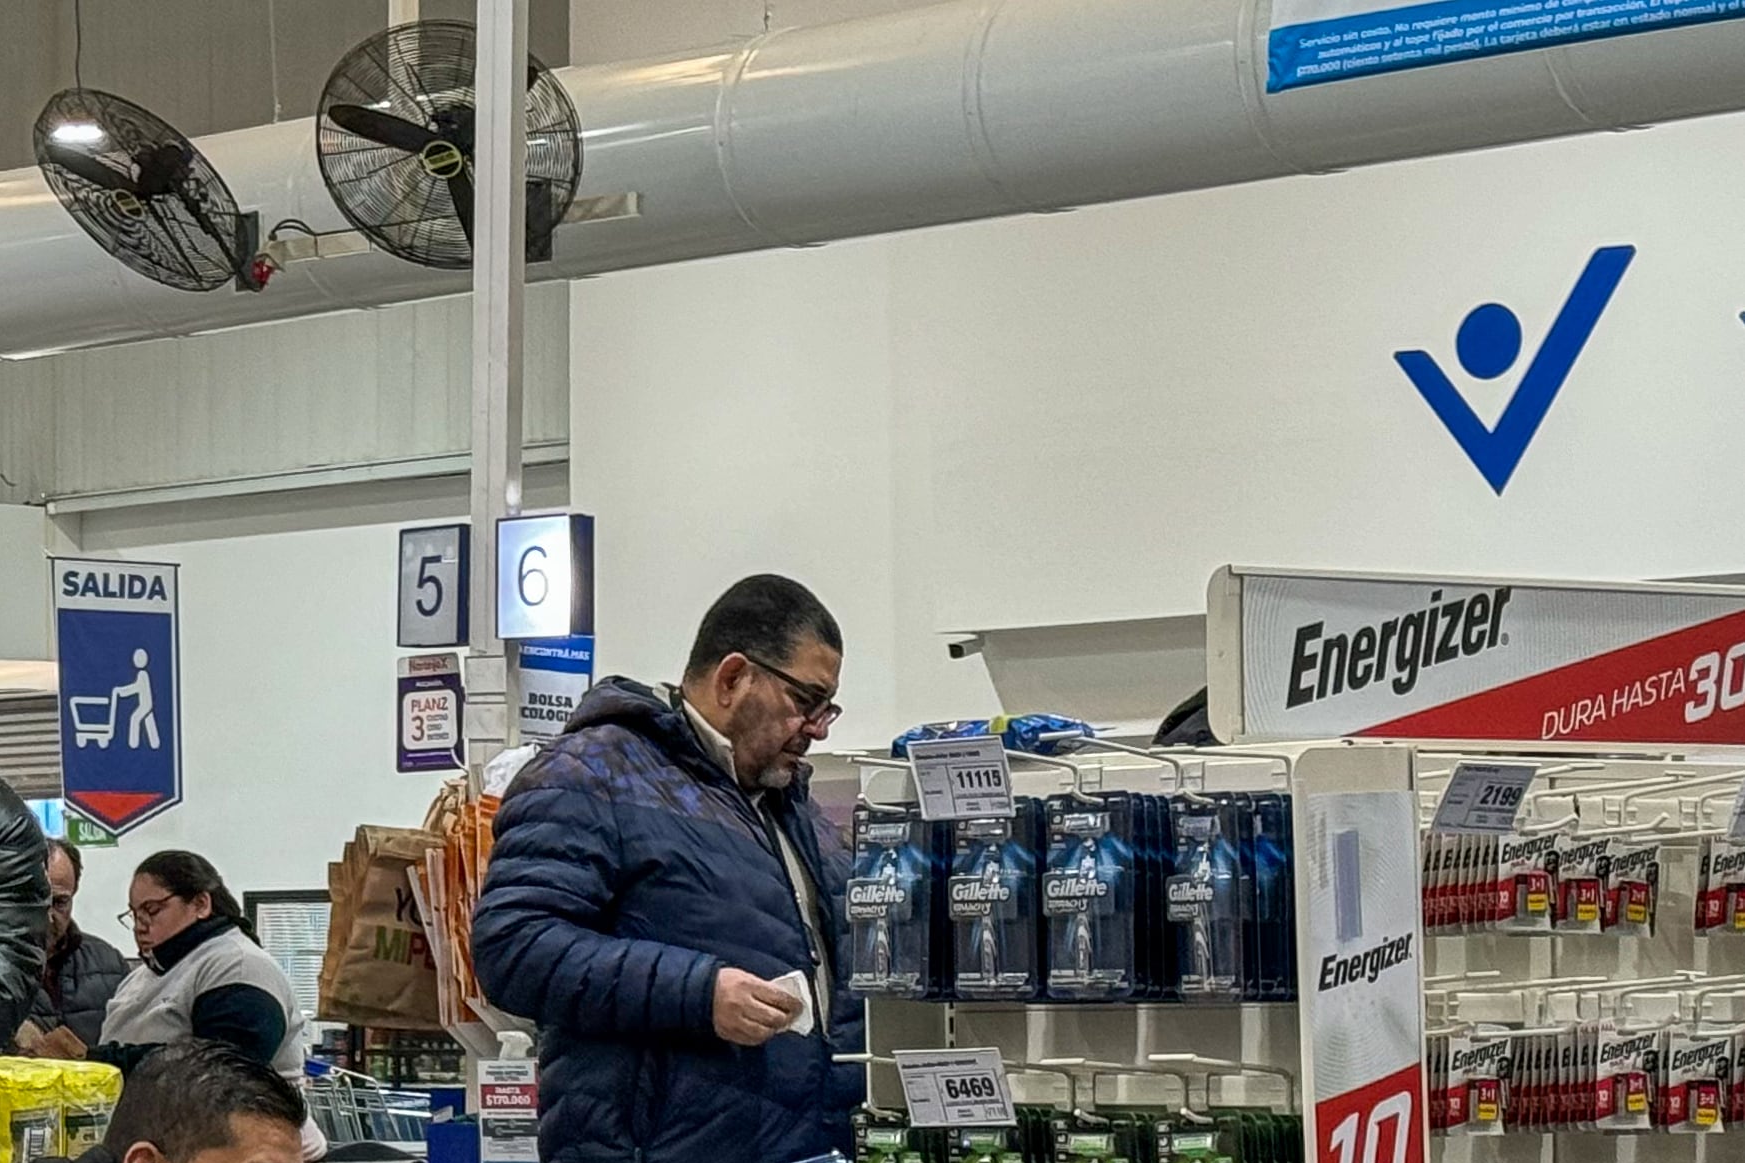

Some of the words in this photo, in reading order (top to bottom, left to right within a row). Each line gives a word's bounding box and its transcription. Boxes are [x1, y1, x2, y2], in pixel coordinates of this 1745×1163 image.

[62, 570, 167, 603] SALIDA
[416, 555, 442, 616] 5
[518, 545, 548, 607] 6
[1285, 586, 1511, 711] Energizer
[528, 693, 573, 709] BOLSA
[1541, 694, 1606, 741] DURA
[1610, 668, 1686, 719] HASTA
[411, 715, 425, 742] 3
[957, 769, 1001, 789] 11115
[1479, 784, 1523, 806] 2199
[849, 879, 906, 904] Gillette
[952, 879, 1010, 903] Gillette
[1046, 876, 1107, 899] Gillette
[1168, 881, 1213, 903] Gillette
[1318, 932, 1412, 992] Energizer
[1453, 1038, 1508, 1071] Energizer
[1600, 1033, 1655, 1064] Energizer
[1671, 1039, 1729, 1070] Energizer
[946, 1075, 995, 1099] 6469
